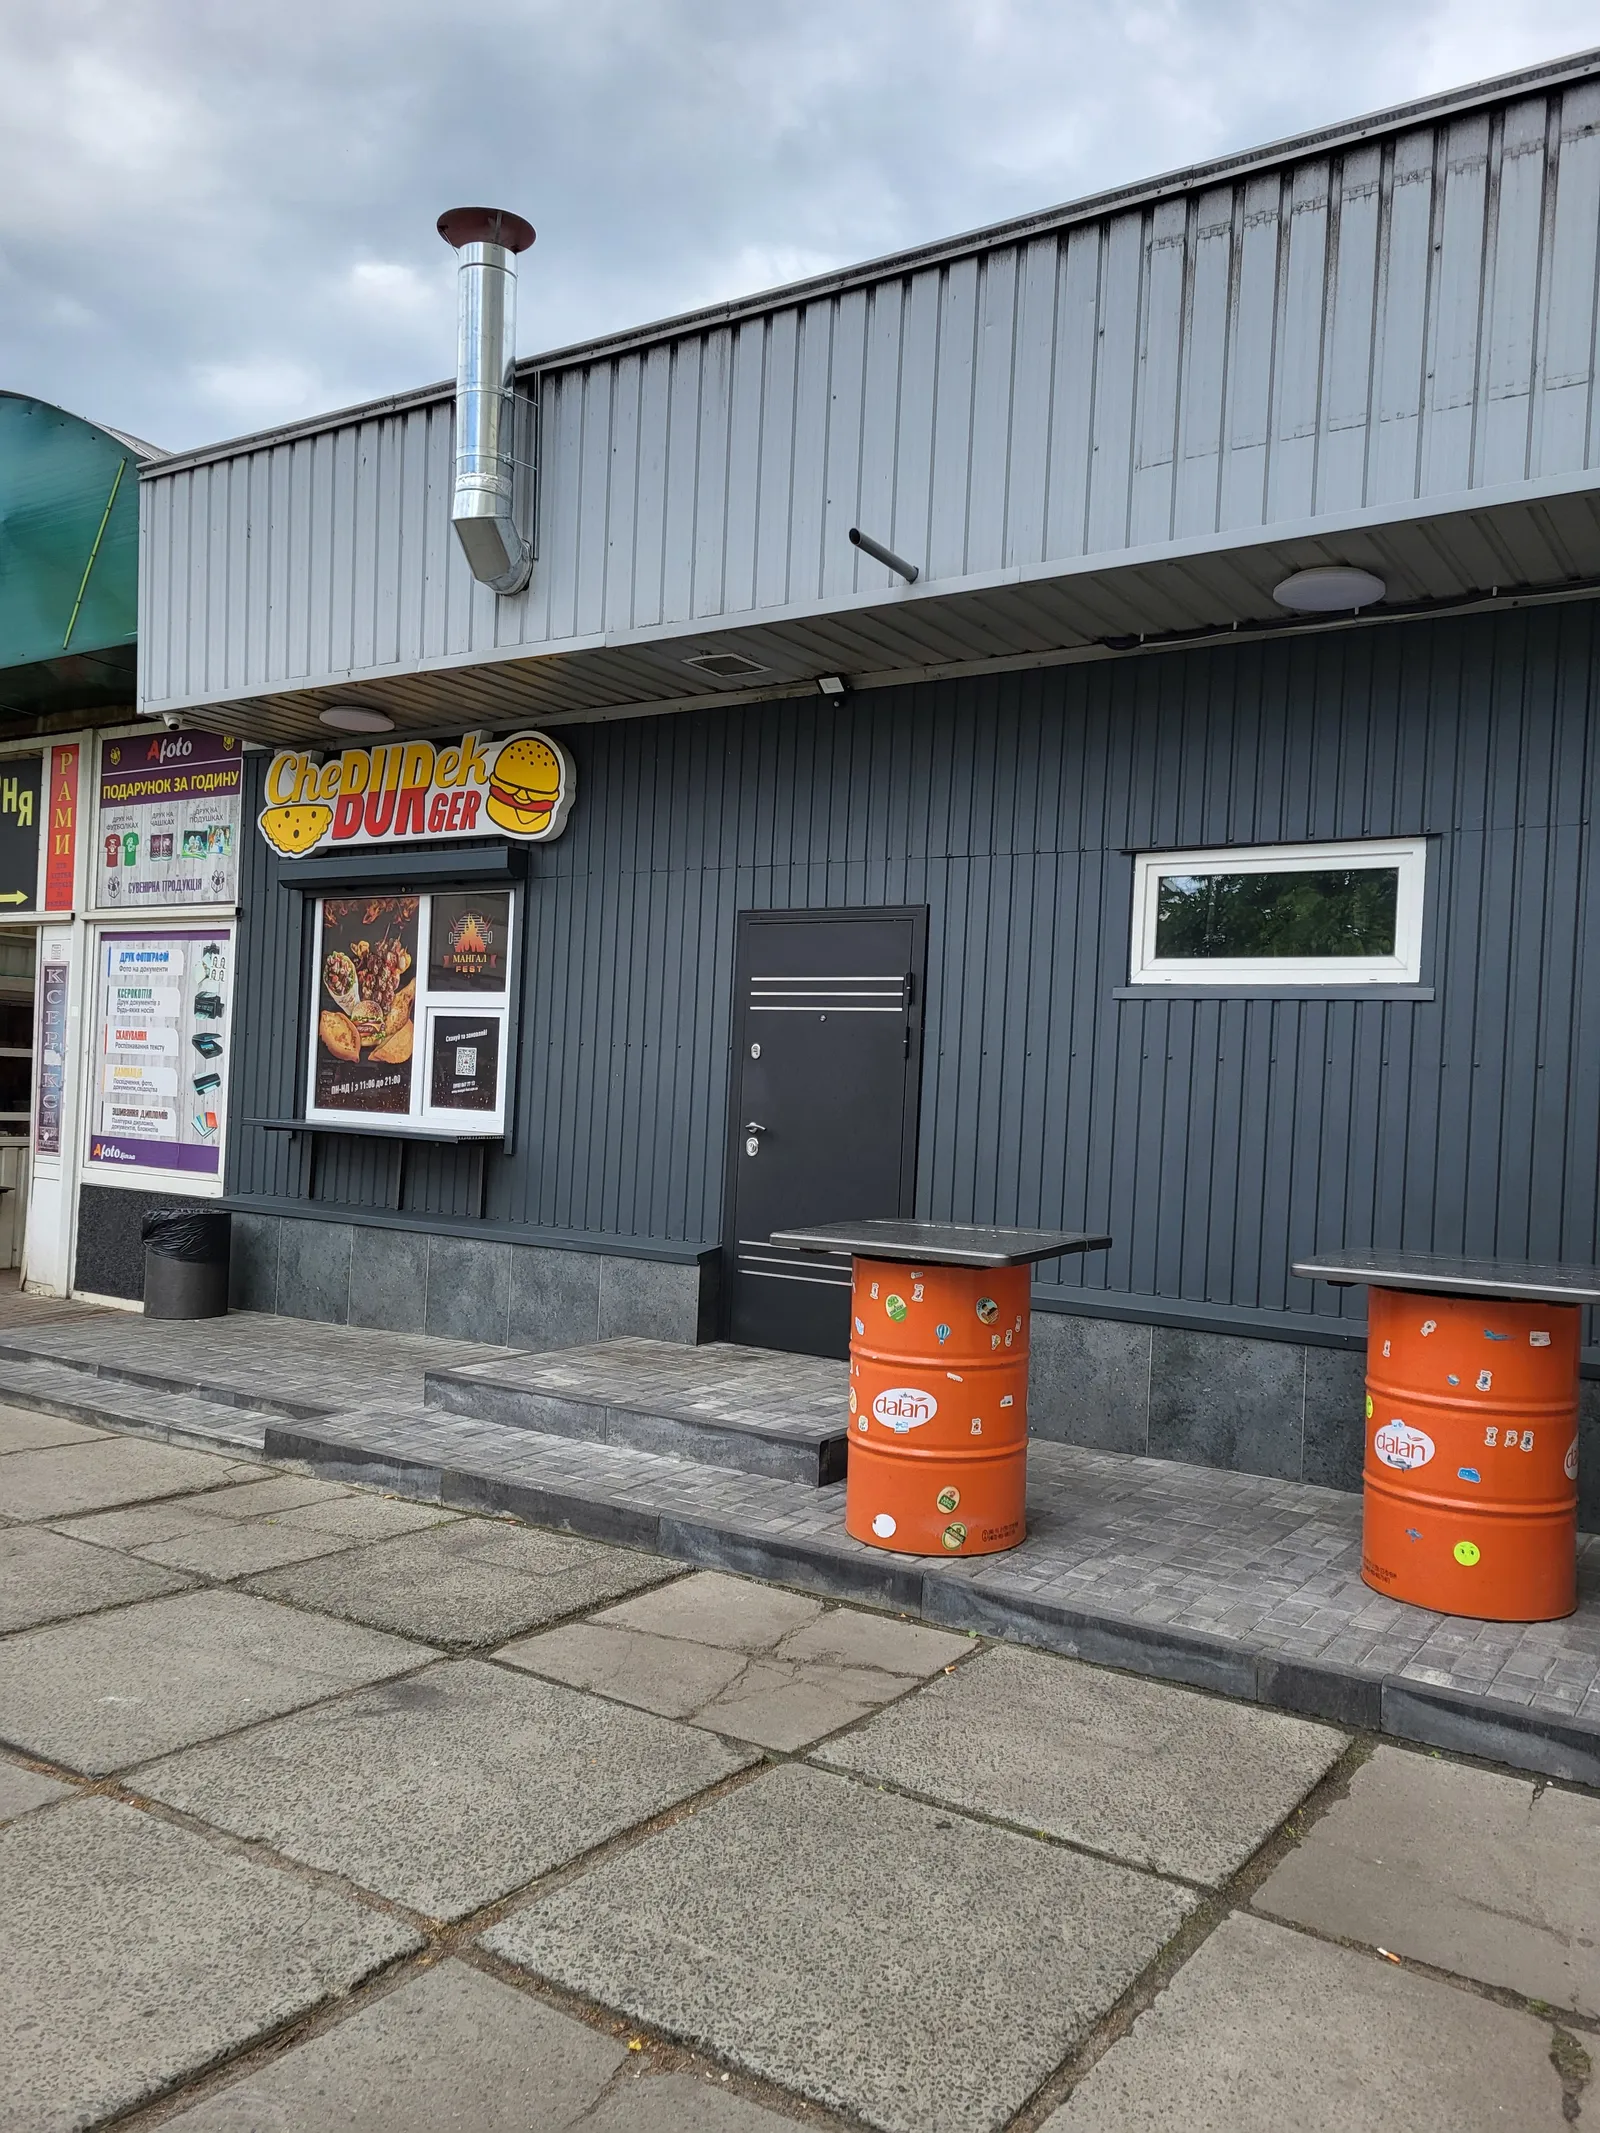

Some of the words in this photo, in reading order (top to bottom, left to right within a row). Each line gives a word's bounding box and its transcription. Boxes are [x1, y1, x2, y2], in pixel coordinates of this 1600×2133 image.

[147, 737, 192, 764] Afoto
[103, 779, 171, 801] ПОДАРУНОК
[174, 777, 188, 792] ЗА
[191, 771, 239, 792] ГОДИНУ
[54, 752, 73, 855] РАМИ
[152, 812, 165, 820] ДРУК
[189, 814, 224, 824] ПОДУШКАХ
[150, 819, 175, 827] ЧАШКАХ
[128, 881, 160, 894] СУВЕНІРНА
[162, 878, 202, 893] ПРОДУКЦІЯ
[120, 952, 134, 963] ДРУК
[453, 954, 487, 963] МАНГАЛ
[140, 966, 168, 974] документи
[117, 988, 152, 999] КСЕРОКОПІЯ
[116, 1030, 147, 1041] СКАНУВАННЯ
[331, 1083, 350, 1094] ПН-НД
[376, 1080, 383, 1088] до
[384, 1075, 401, 1086] 21:00
[94, 1144, 120, 1160] Afoto
[876, 1397, 929, 1419] dalan
[1377, 1432, 1426, 1461] dalan
